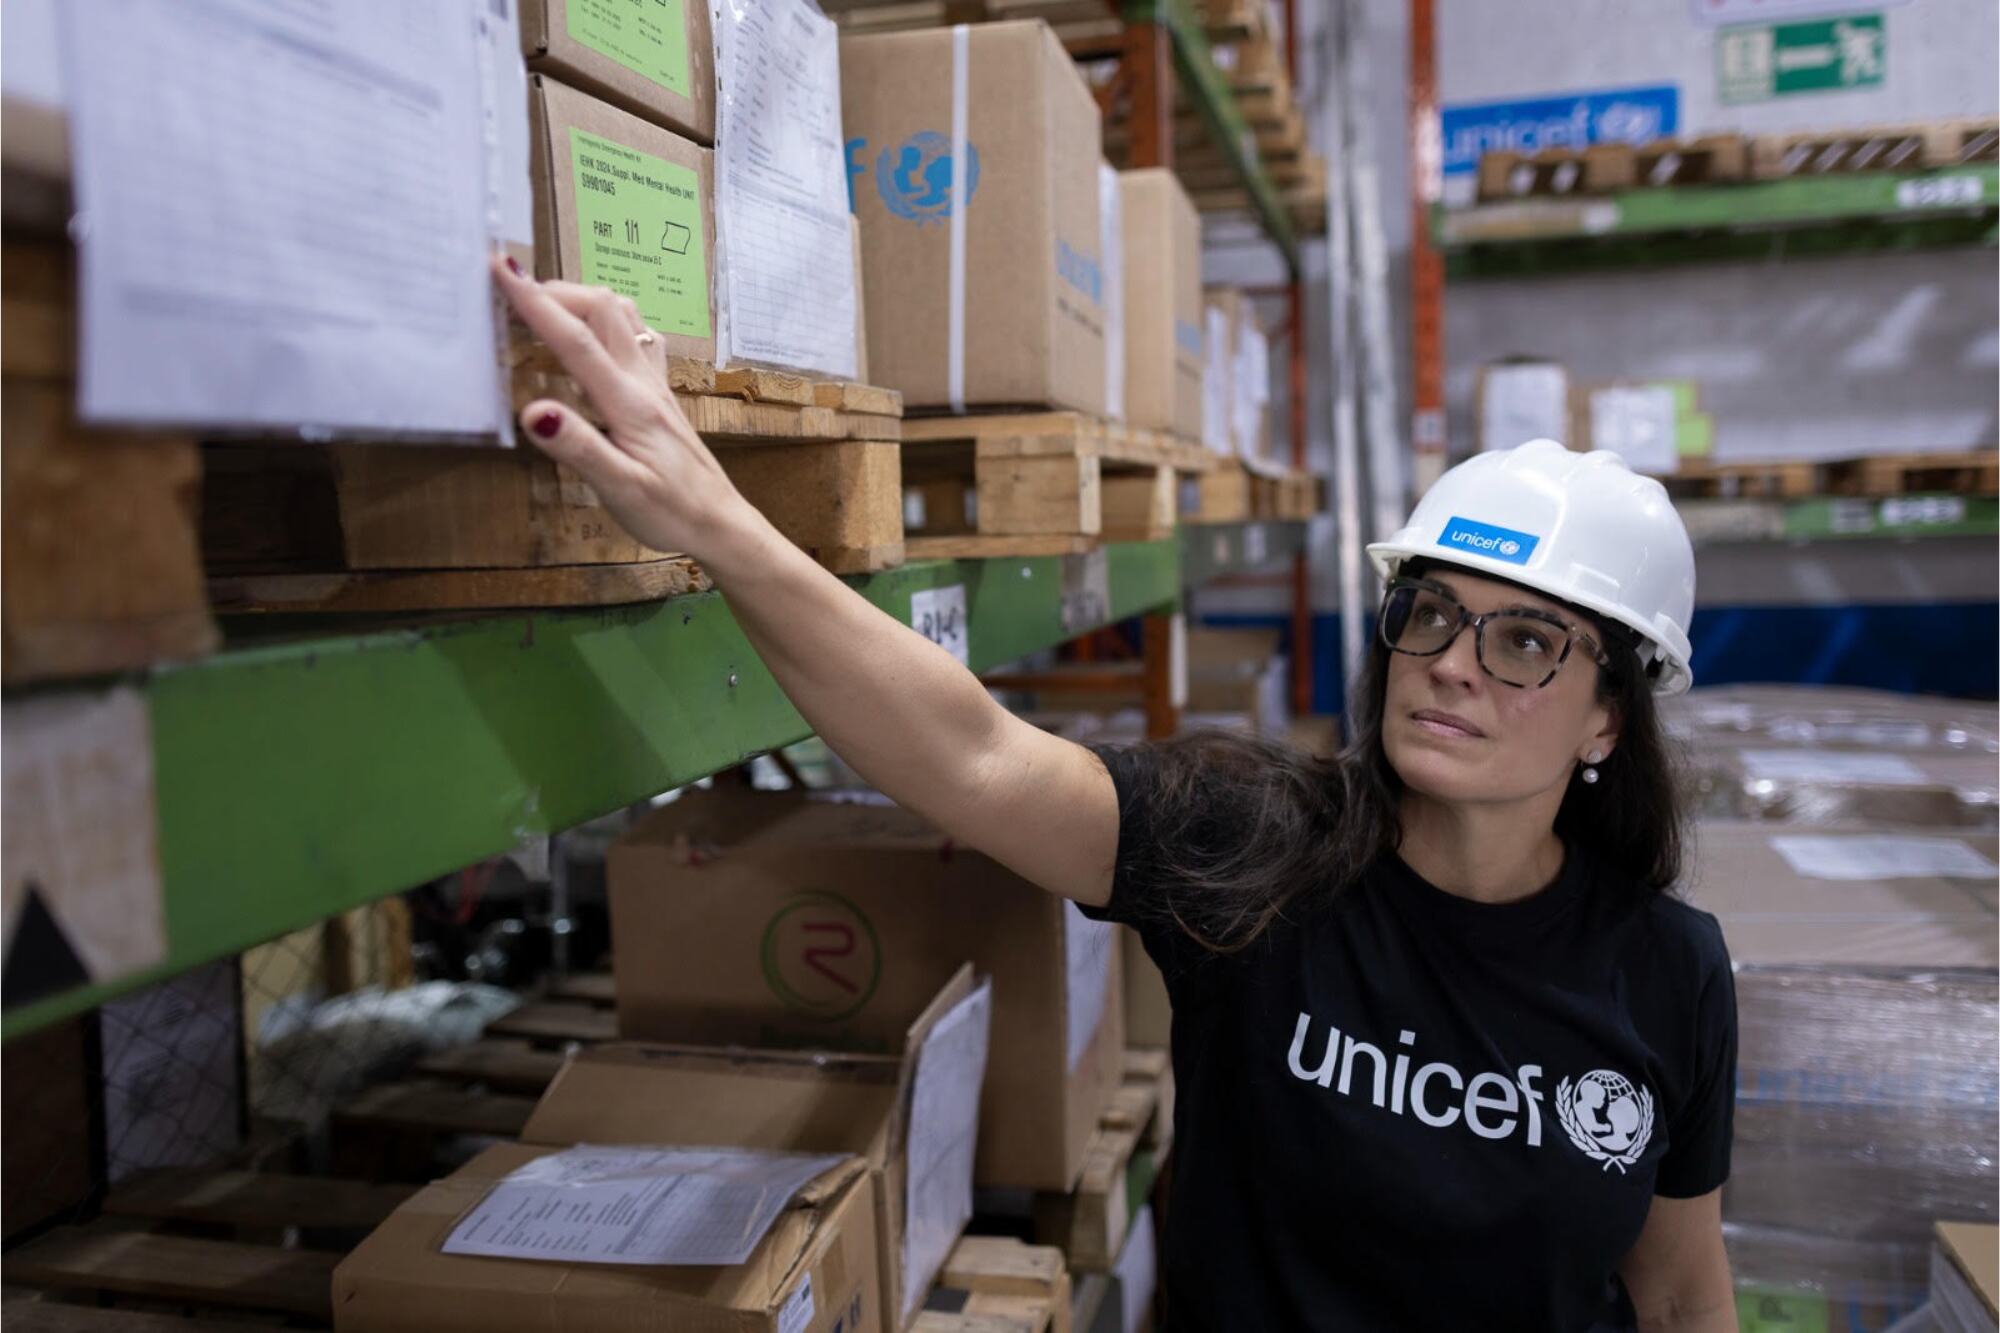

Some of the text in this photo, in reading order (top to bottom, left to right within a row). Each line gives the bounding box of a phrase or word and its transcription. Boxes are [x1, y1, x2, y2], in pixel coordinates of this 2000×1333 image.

[593, 219, 640, 245] PART 1/1
[1451, 530, 1503, 551] unicef
[1287, 1011, 1545, 1147] unicef
